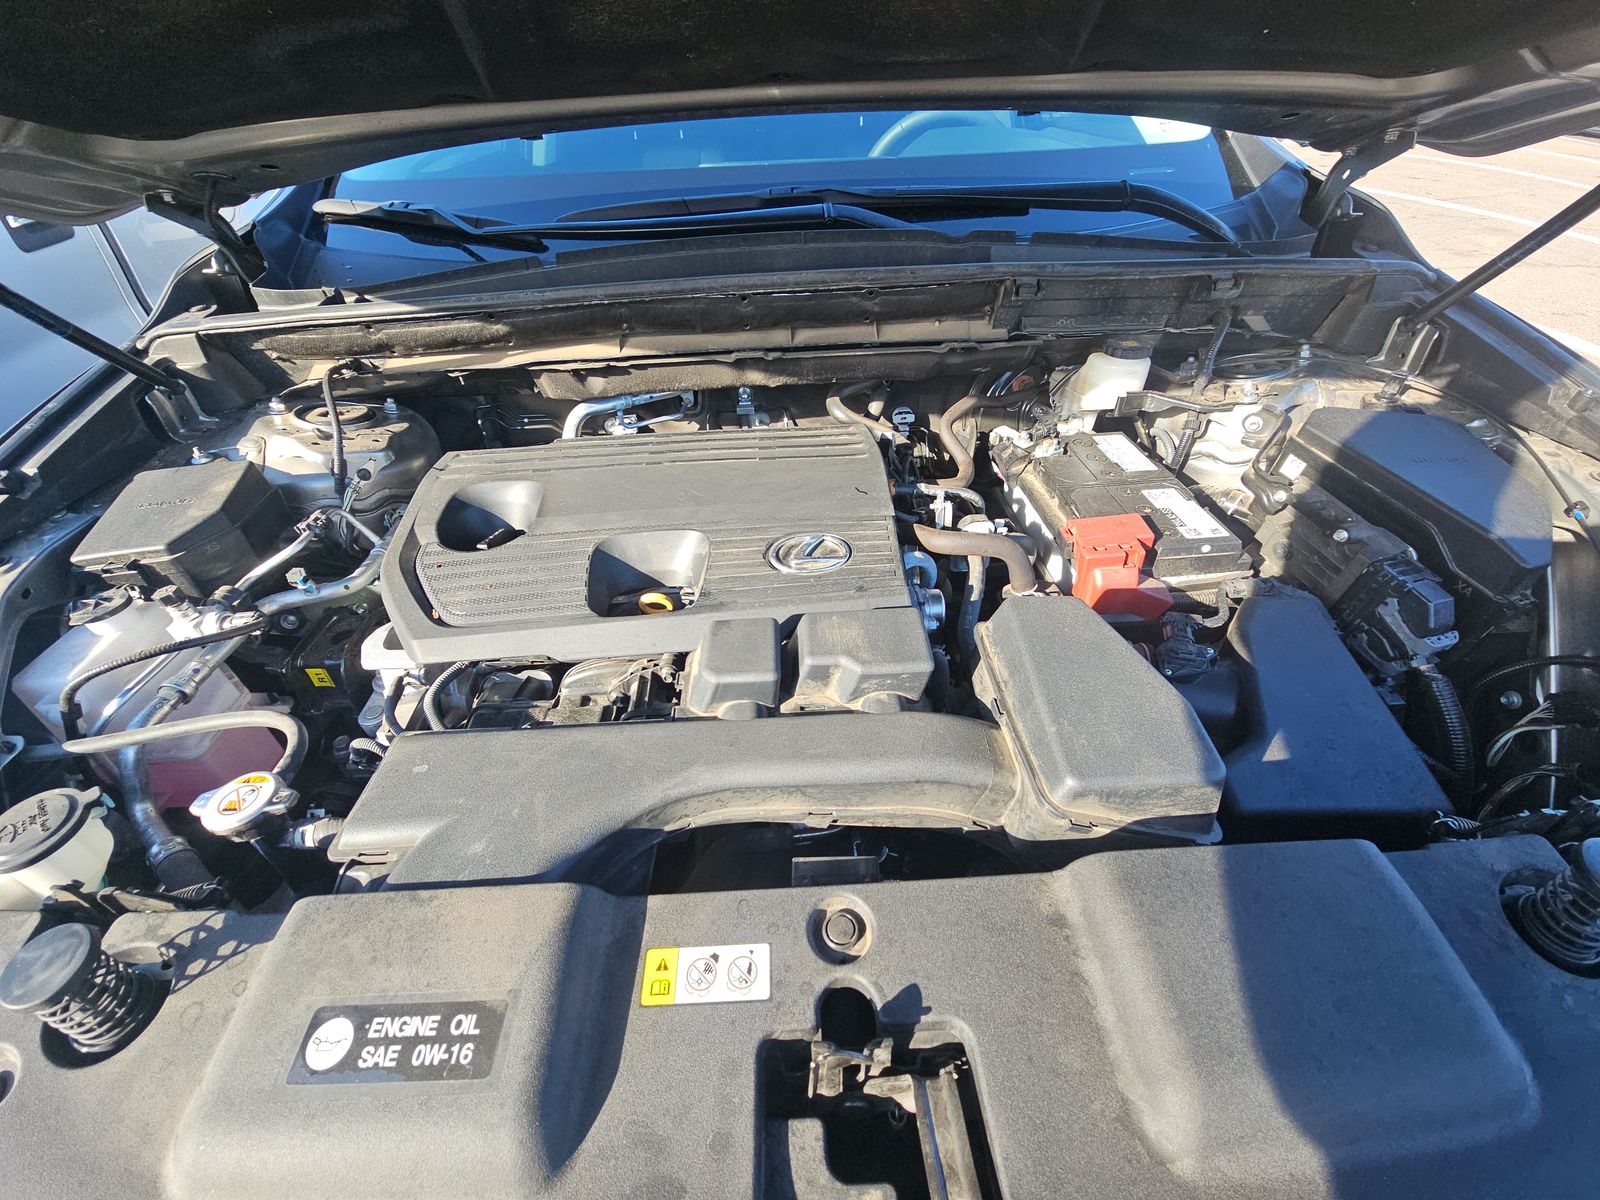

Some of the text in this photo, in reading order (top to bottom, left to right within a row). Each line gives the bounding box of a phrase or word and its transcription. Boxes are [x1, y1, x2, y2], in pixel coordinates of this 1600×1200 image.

[367, 1013, 480, 1038] ENGINE OIL
[357, 1043, 474, 1068] SAE 0W-16
